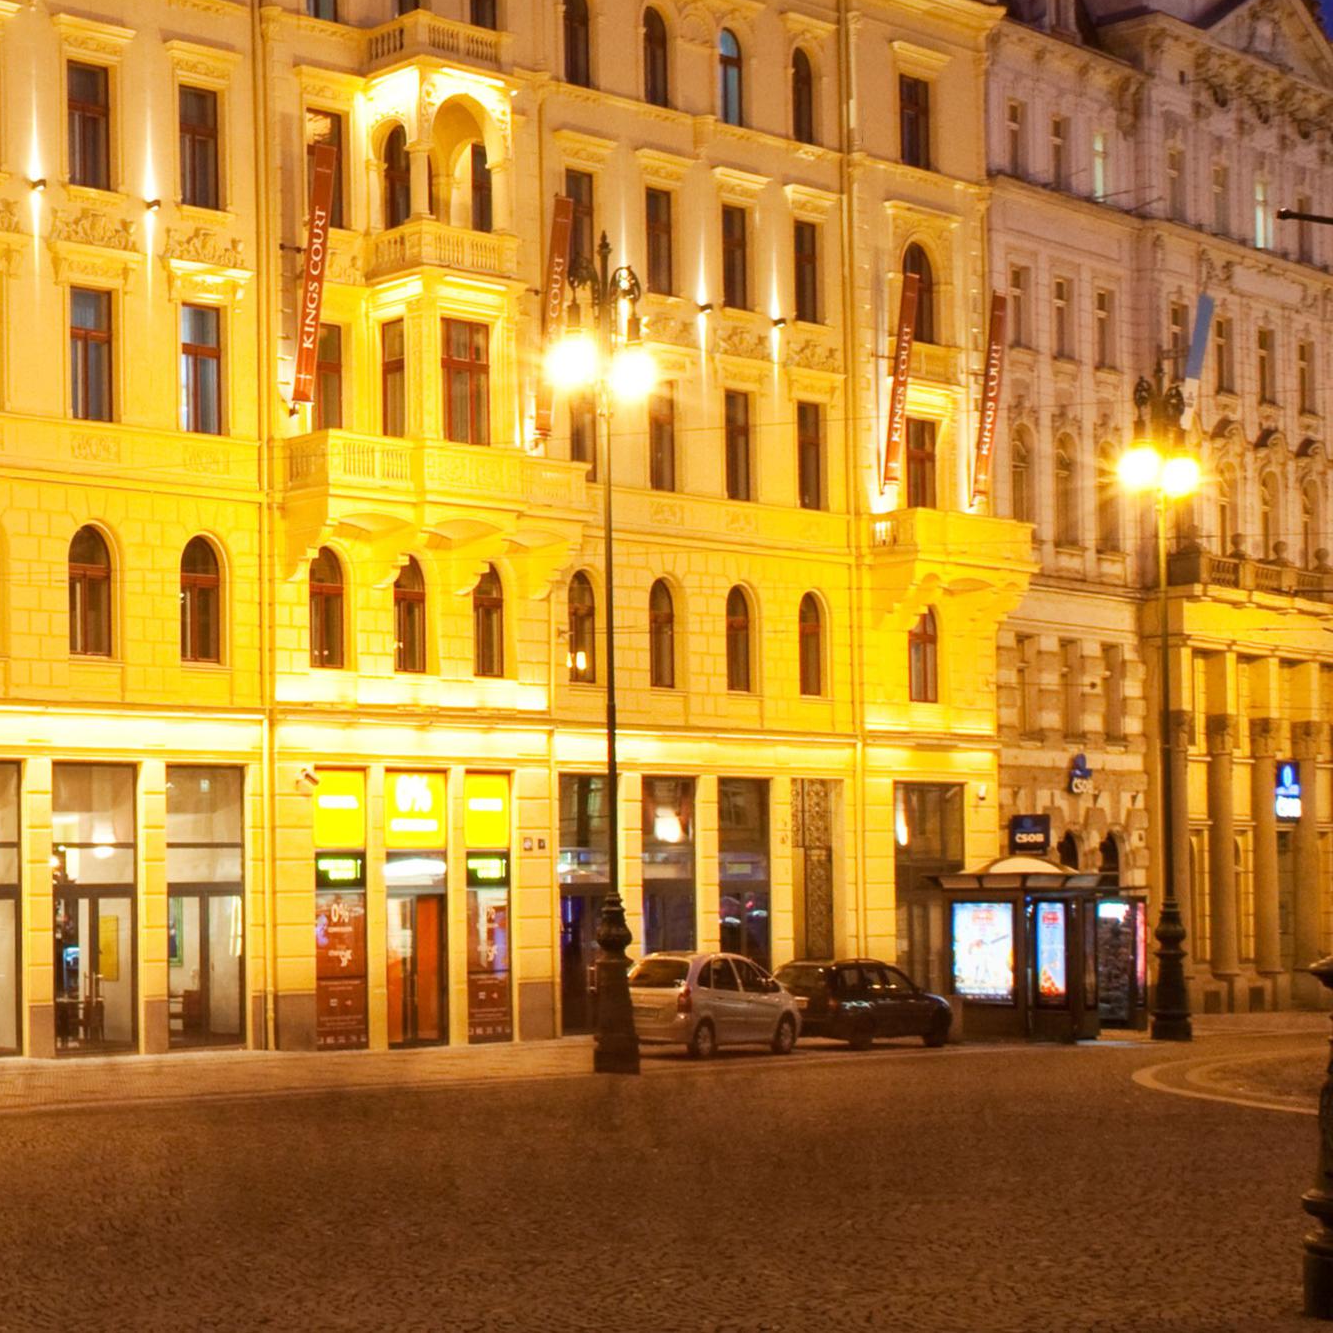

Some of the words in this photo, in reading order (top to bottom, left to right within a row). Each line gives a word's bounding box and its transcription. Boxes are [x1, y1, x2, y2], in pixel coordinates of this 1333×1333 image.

[309, 205, 326, 276] COURT
[549, 254, 564, 318] COURT
[302, 281, 319, 349] KINGS
[898, 325, 912, 381] COURT
[891, 387, 906, 442] KINGS
[981, 402, 996, 456] KINGS
[331, 903, 349, 923] 0%
